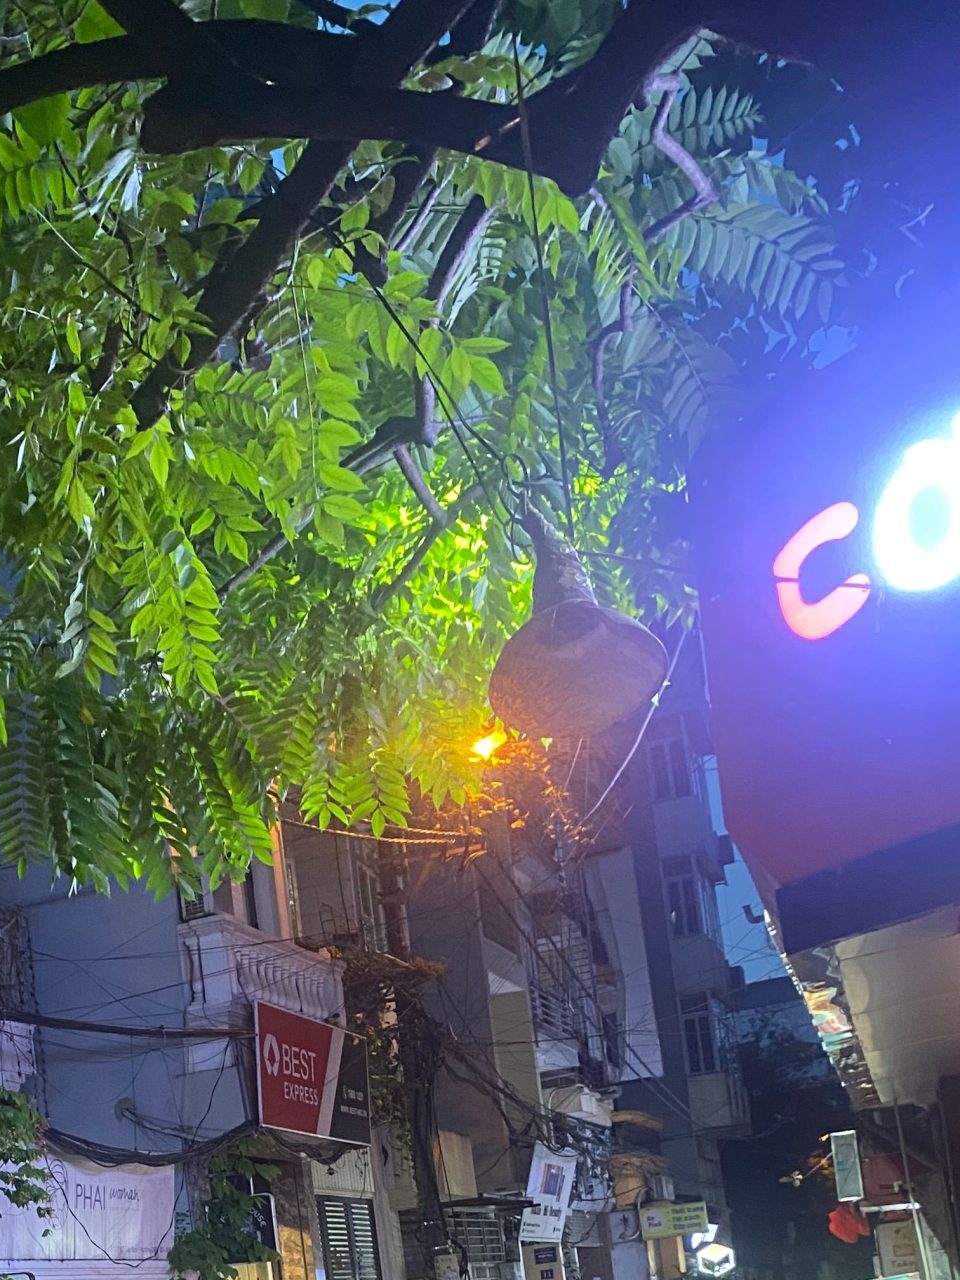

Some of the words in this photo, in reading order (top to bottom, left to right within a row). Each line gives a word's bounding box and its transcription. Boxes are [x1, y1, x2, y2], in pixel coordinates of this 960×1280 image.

[282, 1044, 317, 1082] BEST
[284, 1081, 319, 1106] EXPRESS
[75, 1183, 106, 1210] PHAI
